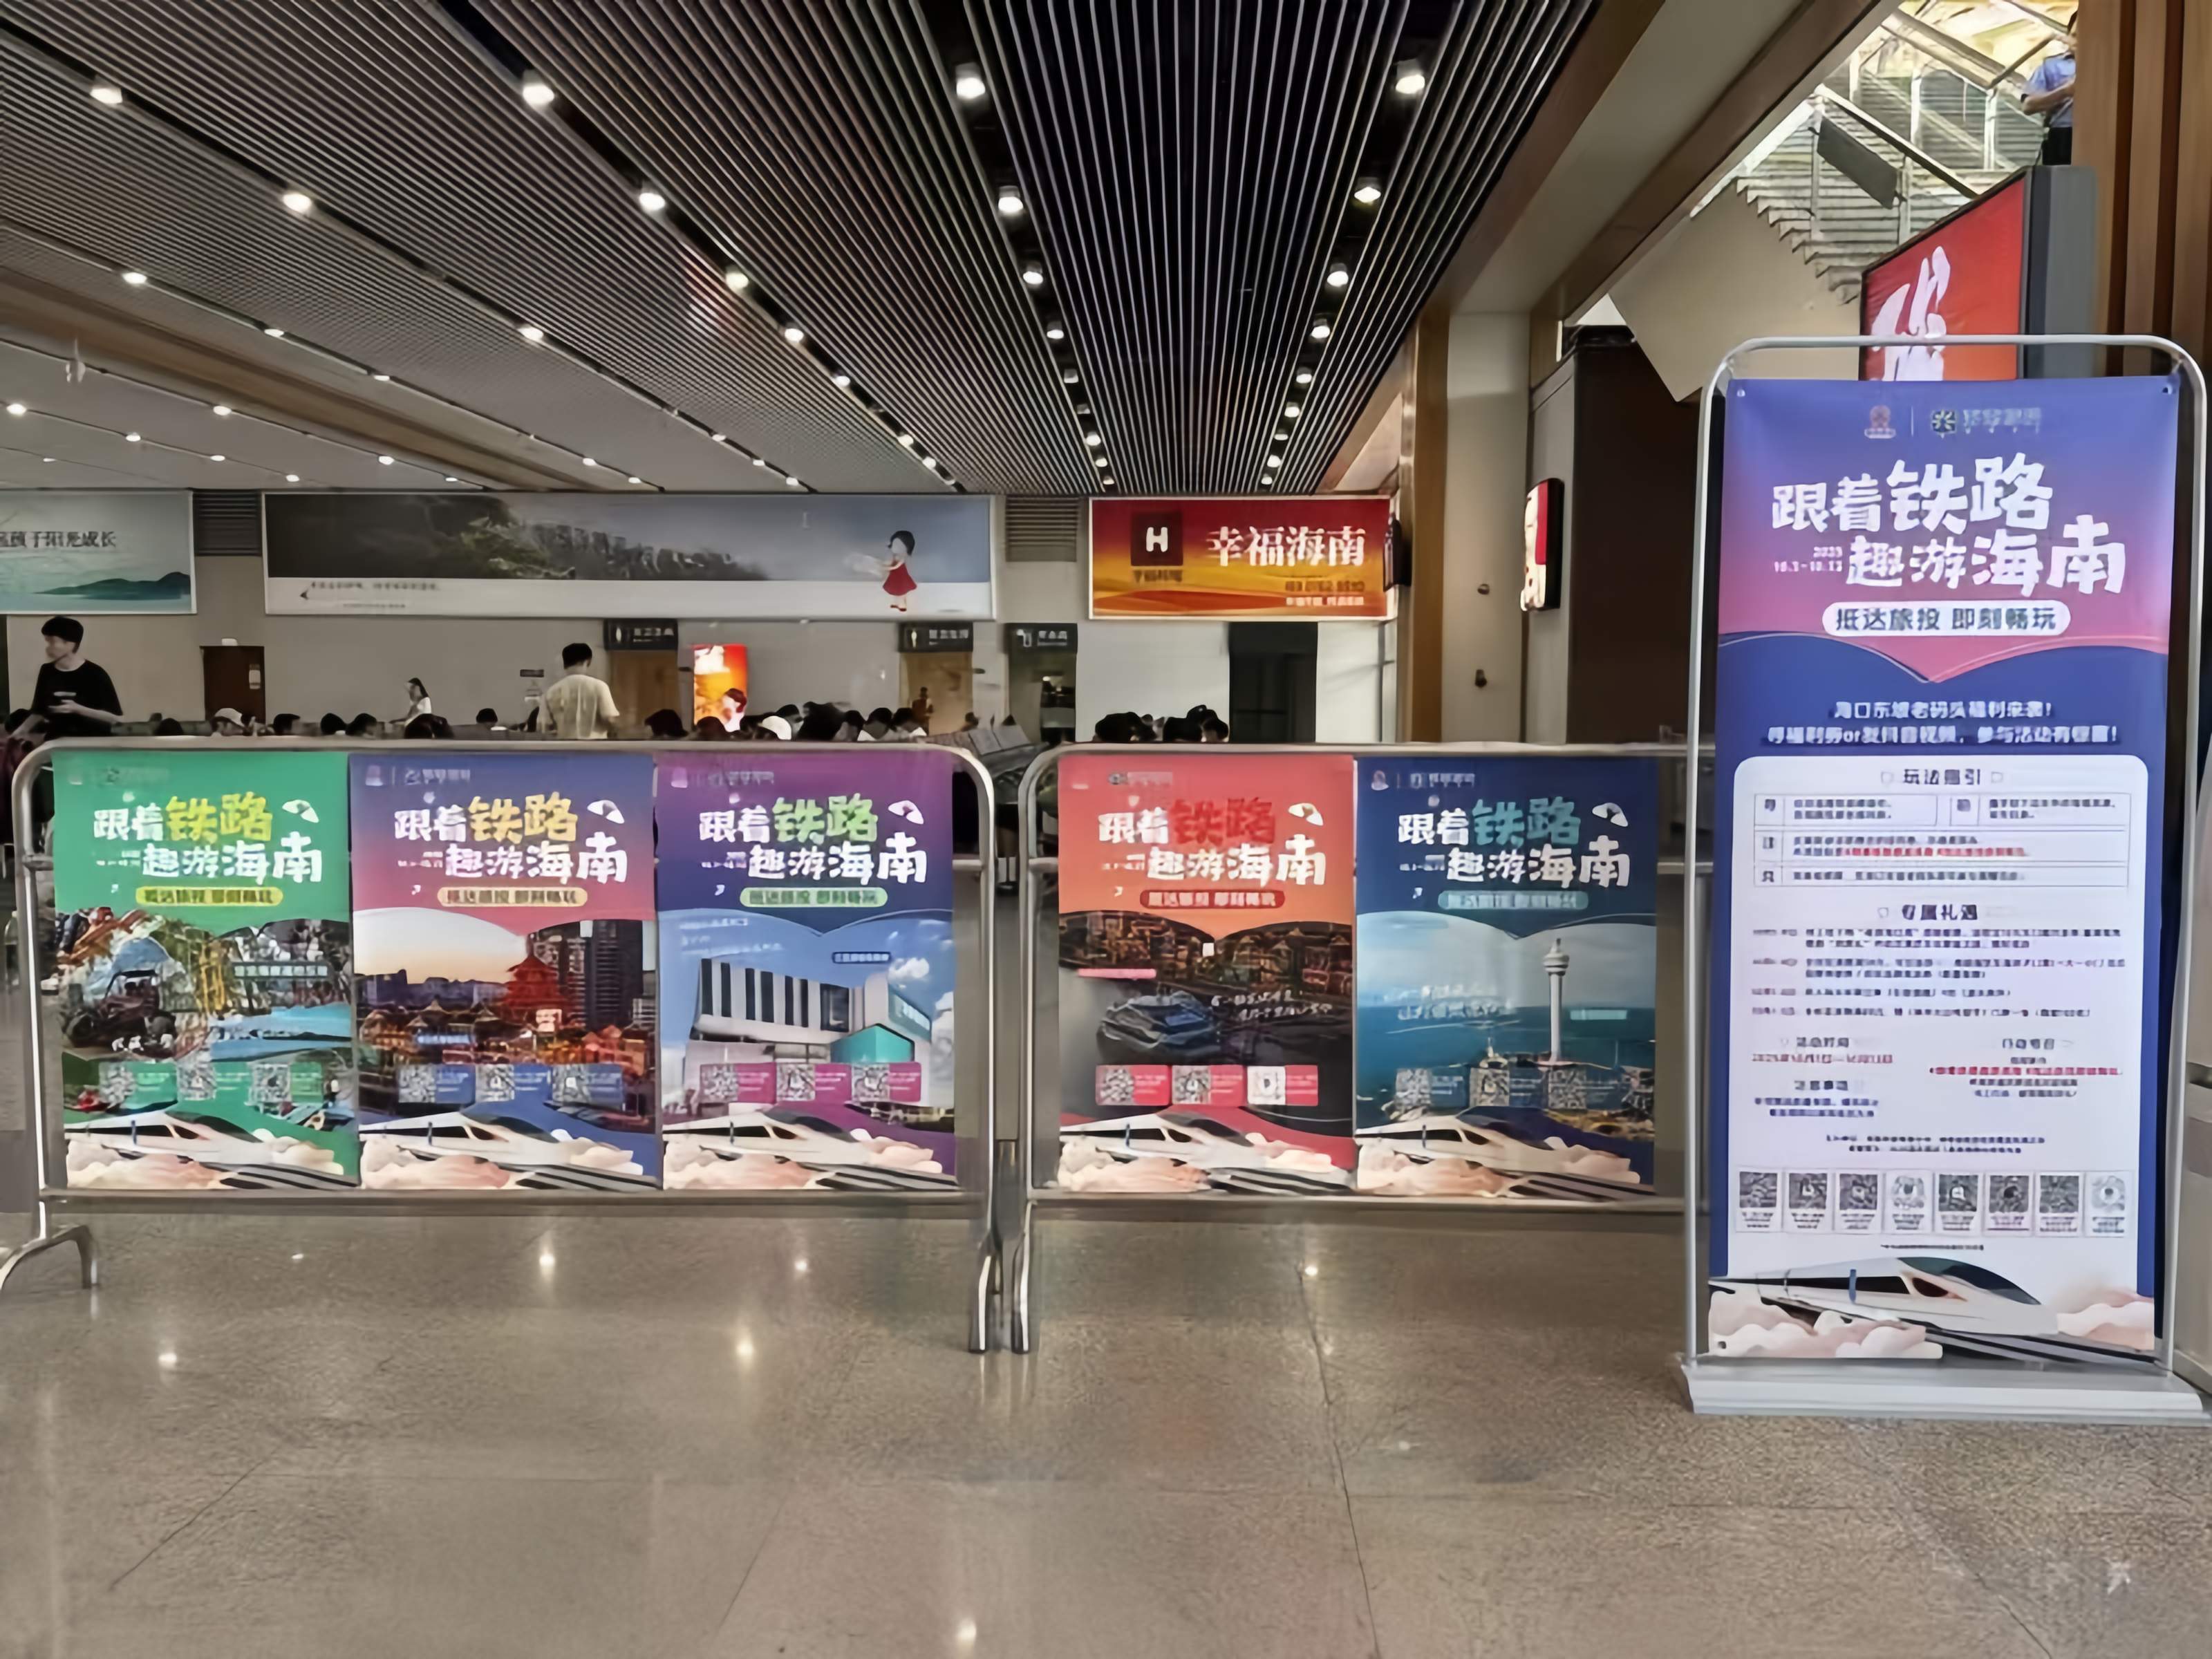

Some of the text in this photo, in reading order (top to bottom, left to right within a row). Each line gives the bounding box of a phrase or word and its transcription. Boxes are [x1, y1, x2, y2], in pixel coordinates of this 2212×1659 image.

[1772, 452, 2053, 535] 跟着铁路
[1146, 527, 1168, 552] H
[1206, 526, 1366, 567] 幸福海南
[1846, 514, 2126, 597] 趣游海南
[1951, 608, 2056, 630] 即刻畅玩
[93, 791, 274, 844] 跟着铁路
[394, 791, 579, 845] 跟着铁路
[699, 793, 878, 845] 跟着铁路
[1098, 797, 1276, 845] 跟着铁路
[1398, 796, 1581, 846] 跟着铁路
[142, 831, 323, 885] 趣游海南
[445, 832, 628, 885] 趣游海南
[748, 832, 927, 885] 趣游海南
[1147, 834, 1326, 888] 趣游海南
[1447, 835, 1630, 888] 趣游海南
